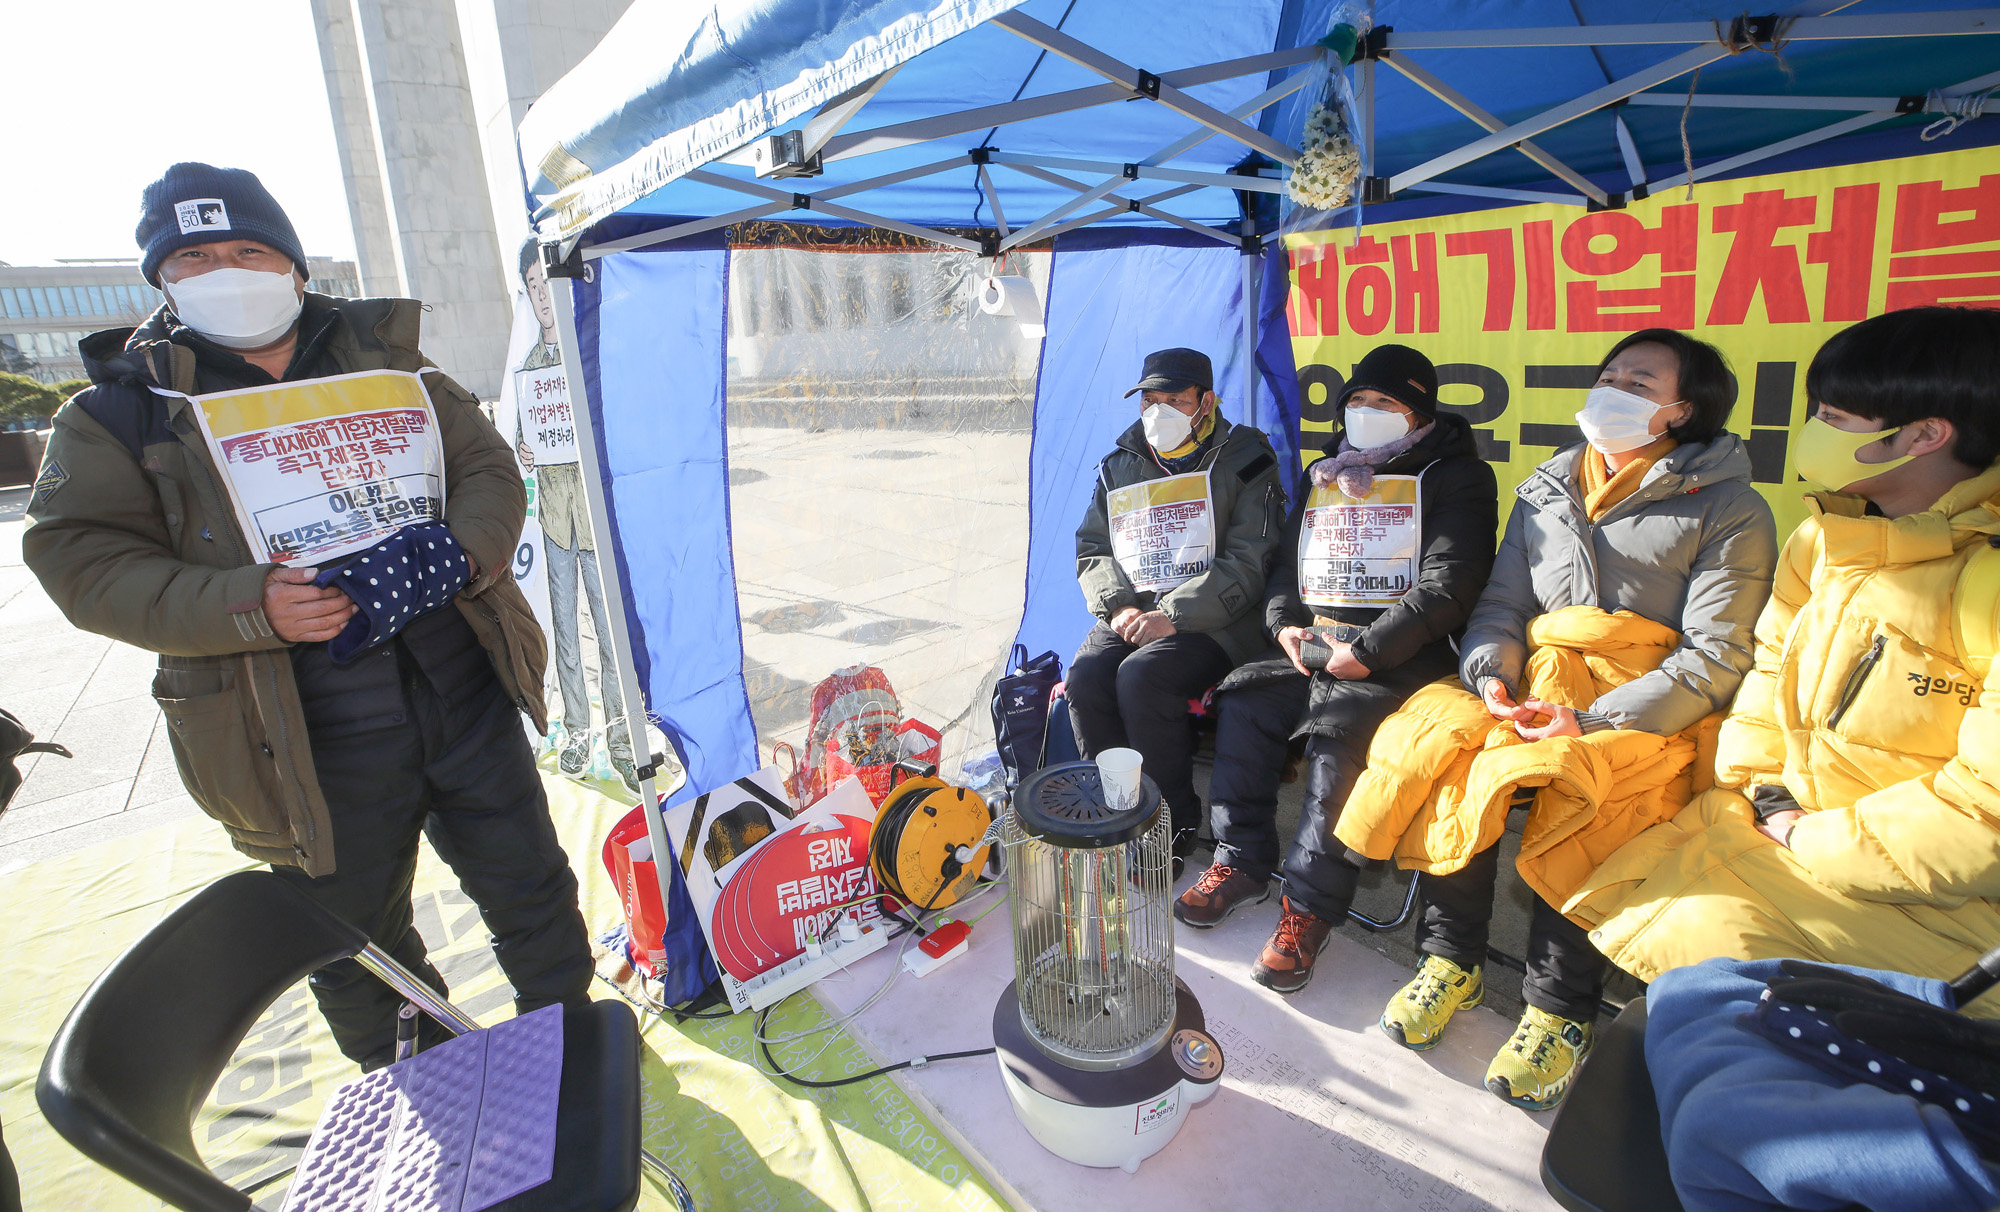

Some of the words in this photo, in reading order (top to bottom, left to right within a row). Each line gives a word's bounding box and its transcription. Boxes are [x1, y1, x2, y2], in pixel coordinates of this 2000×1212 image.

[181, 215, 199, 228] 50
[238, 416, 425, 463] 중대재해기업처벌법
[537, 426, 575, 449] 제정하라
[276, 452, 324, 475] 즉각
[323, 442, 367, 466] 제정
[369, 436, 410, 456] 촉구
[320, 460, 386, 489] 단식자
[329, 481, 401, 514] 이상진
[1115, 505, 1201, 534] 중대재해기업처벌법
[1307, 511, 1406, 529] 중대재해기업처벌법
[268, 509, 373, 554] (민주노총
[1125, 530, 1142, 541] 즉각
[1143, 526, 1163, 538] 제정
[1164, 521, 1187, 534] 촉구
[1314, 528, 1332, 542] 즉각
[1333, 529, 1357, 541] 제정
[1360, 527, 1387, 541] 촉구
[1139, 536, 1170, 552] 단식자
[1328, 543, 1364, 557] 단식자
[1140, 551, 1173, 567] 이용관
[1163, 560, 1204, 577] 아버지)
[1327, 560, 1367, 575] 김미숙
[1317, 575, 1352, 590] 김용균
[1354, 574, 1405, 591] 어머니)
[1907, 672, 1976, 706] 정의당
[807, 836, 855, 872] 제정
[708, 1126, 759, 1185] 사망
